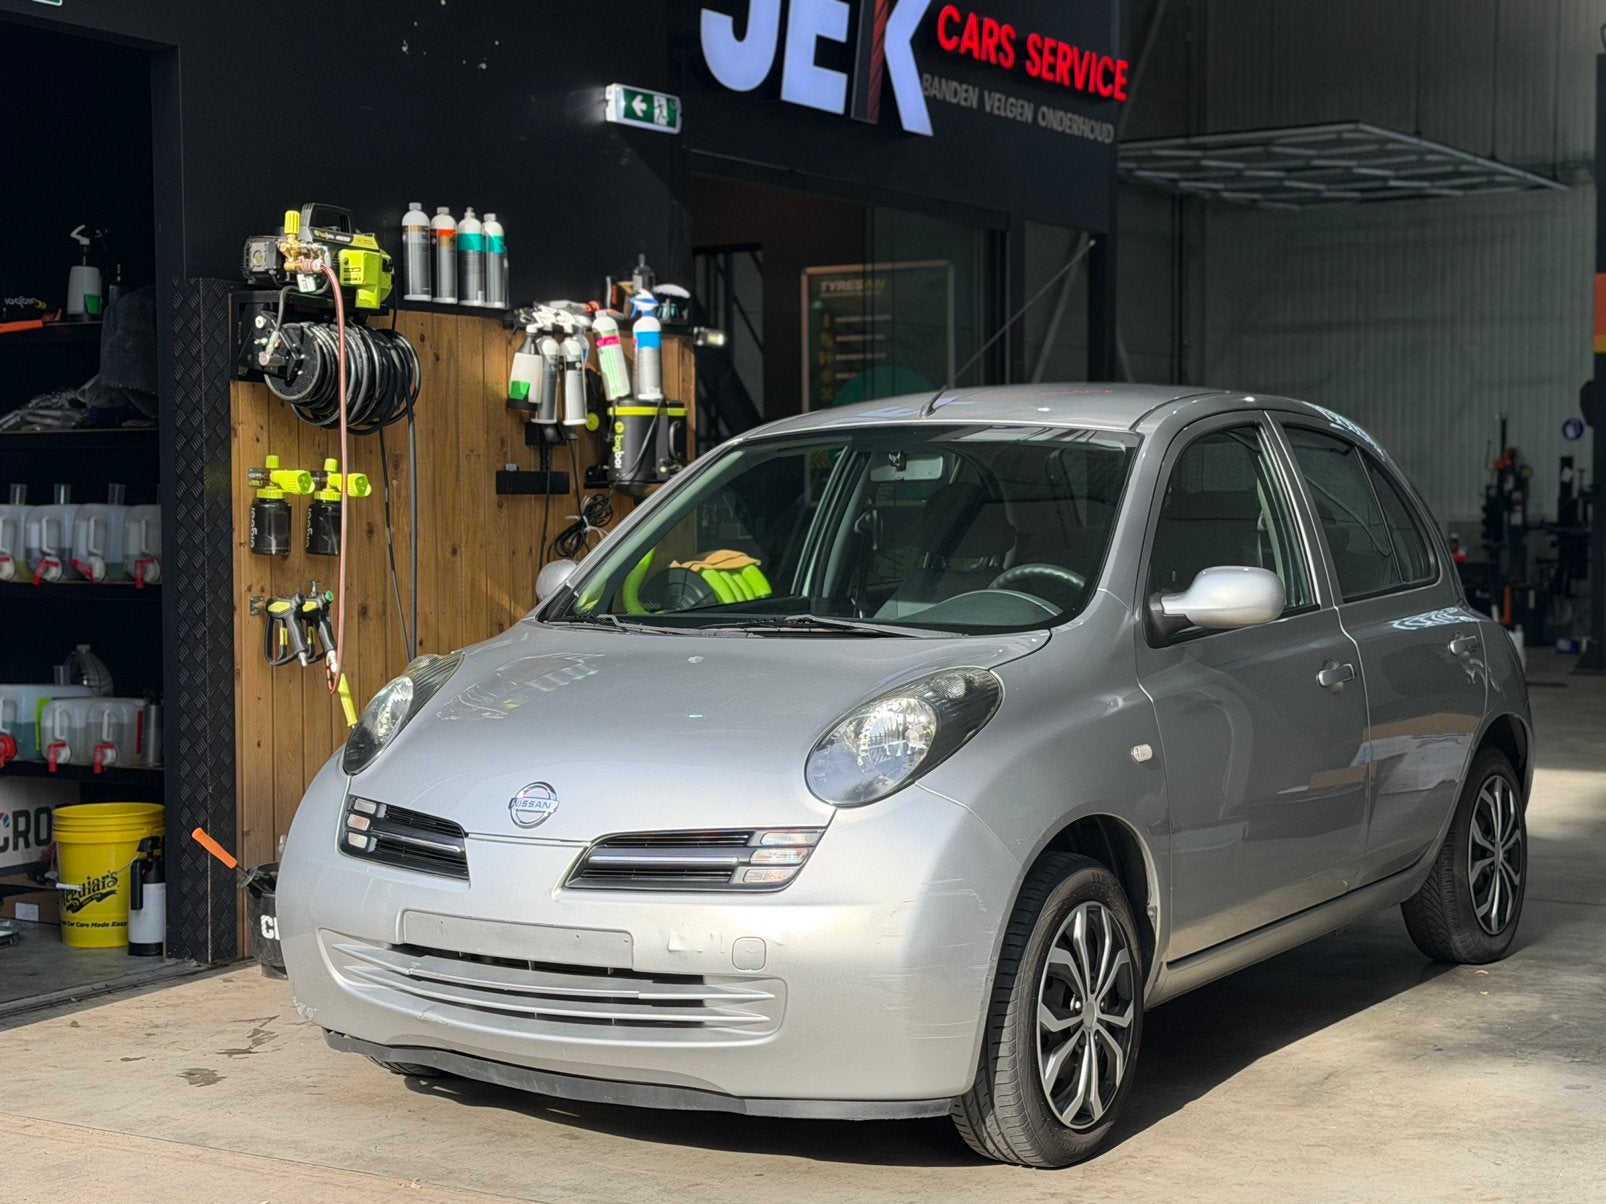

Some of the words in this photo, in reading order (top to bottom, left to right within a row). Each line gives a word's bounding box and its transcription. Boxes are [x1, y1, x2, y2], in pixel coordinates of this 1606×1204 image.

[701, 0, 934, 136] JEK
[937, 4, 1016, 69] CARS
[1025, 33, 1130, 102] SERVICE
[922, 73, 979, 110] BANDEN
[984, 90, 1034, 124] VELGEN
[1038, 106, 1114, 144] ONDERHOUD
[512, 799, 551, 809] NISSAN
